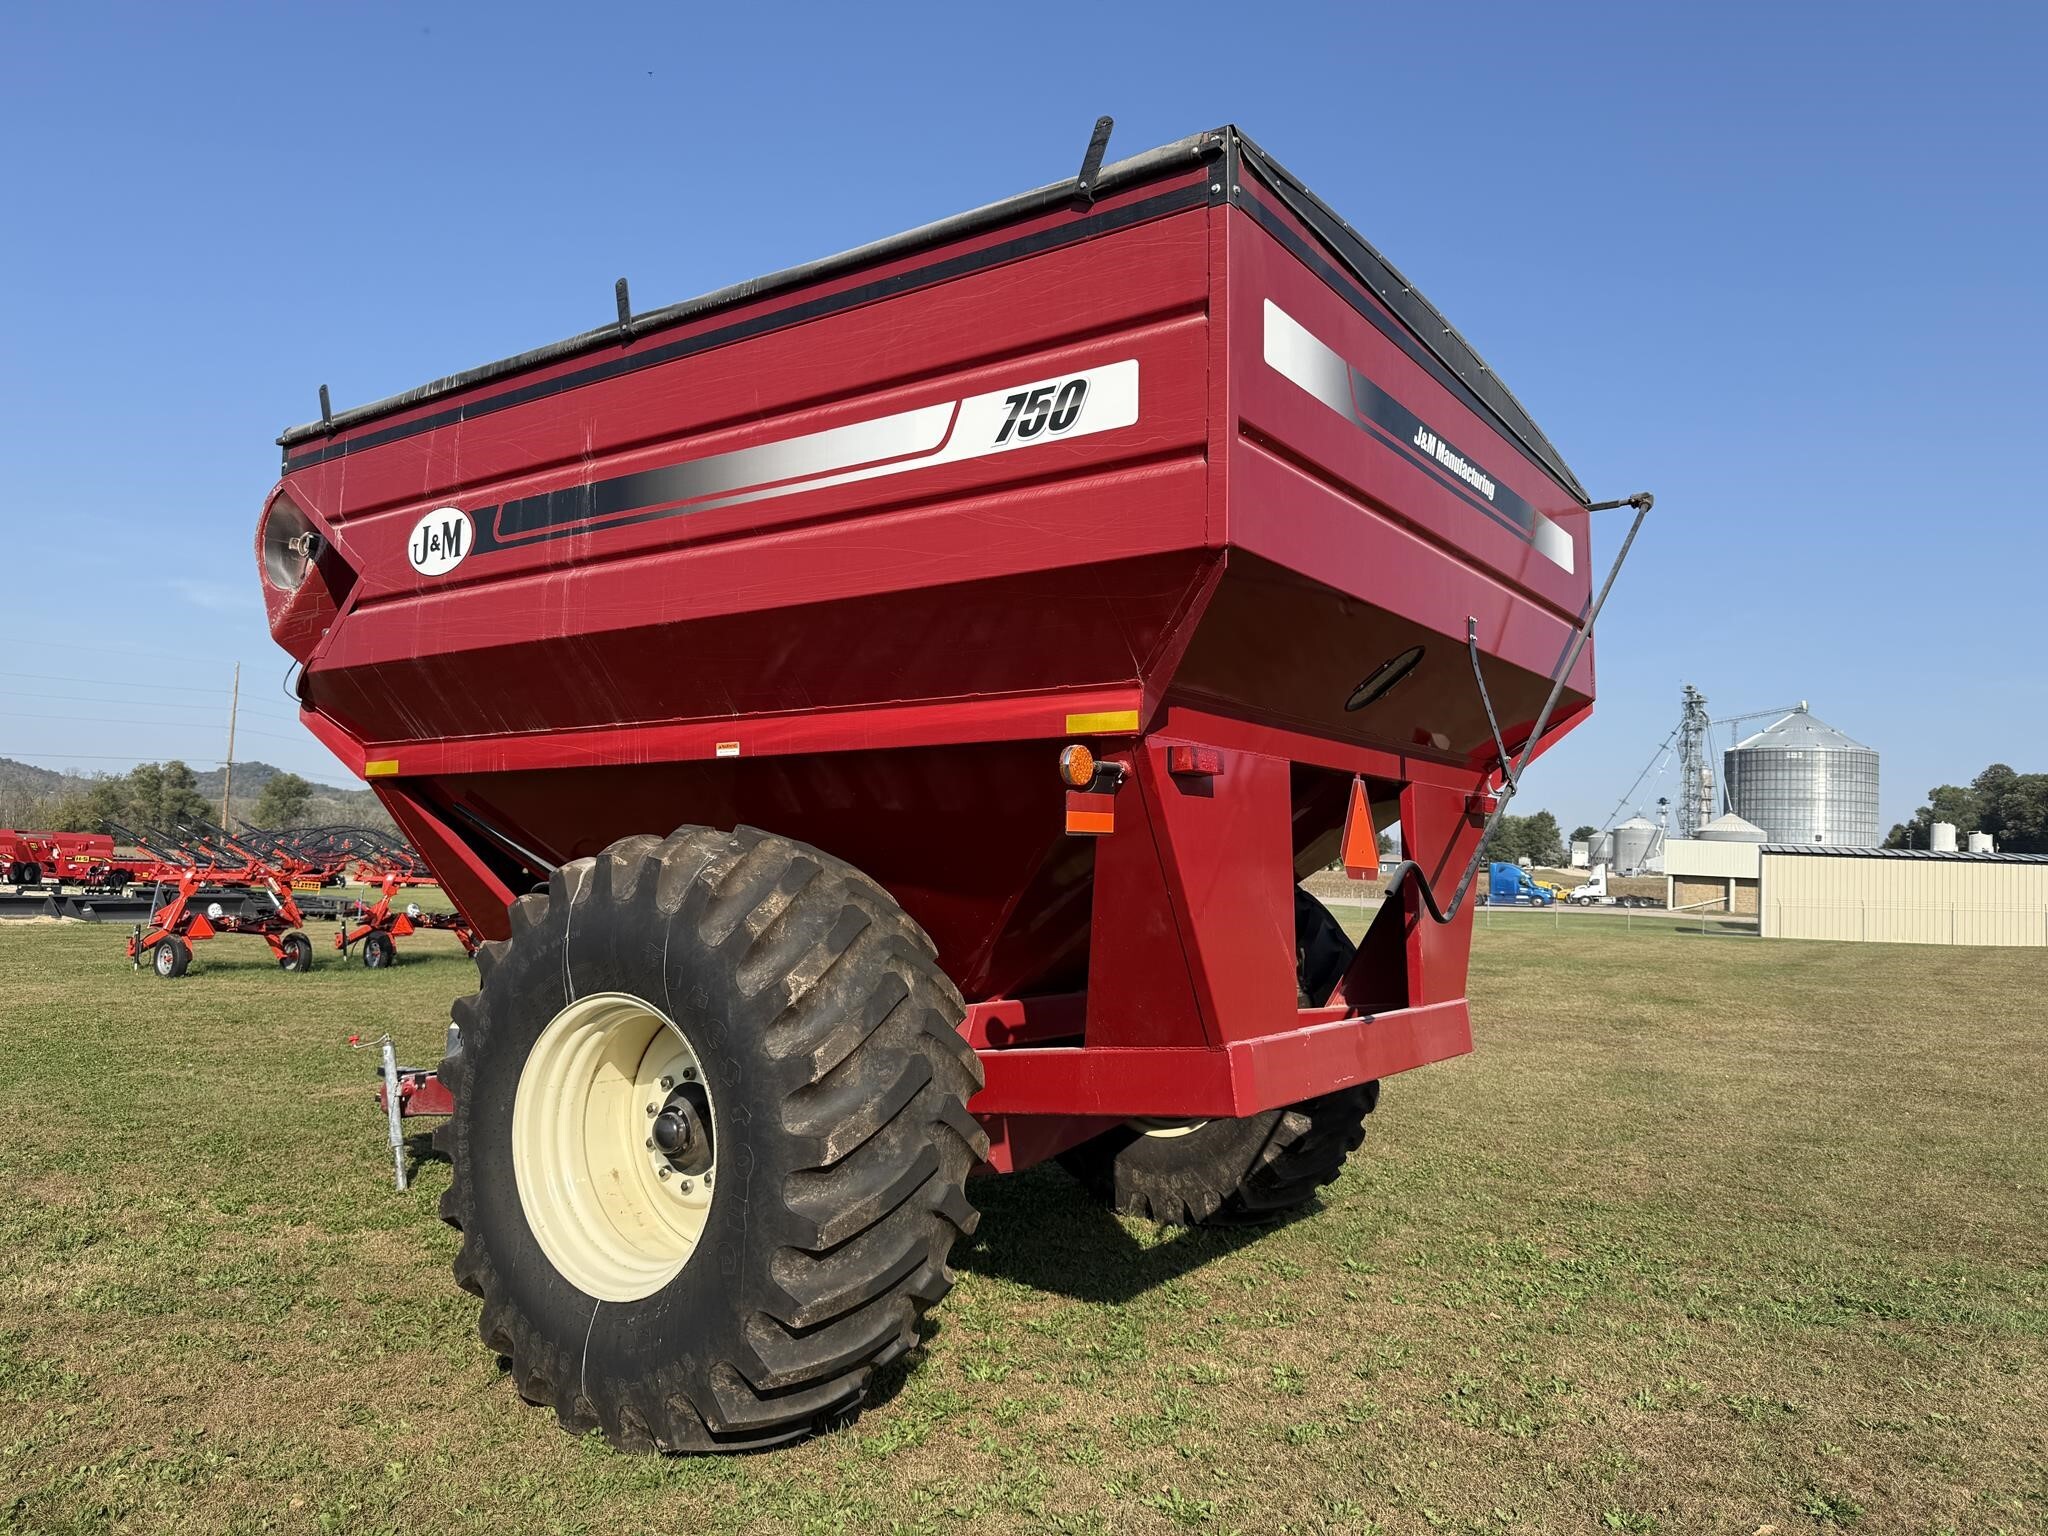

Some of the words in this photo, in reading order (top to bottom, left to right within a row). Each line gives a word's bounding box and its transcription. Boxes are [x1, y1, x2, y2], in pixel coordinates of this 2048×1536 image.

[993, 378, 1089, 445] 750
[1413, 425, 1437, 457] J&M
[1435, 440, 1496, 501] Manufacturing
[413, 518, 463, 565] J&M
